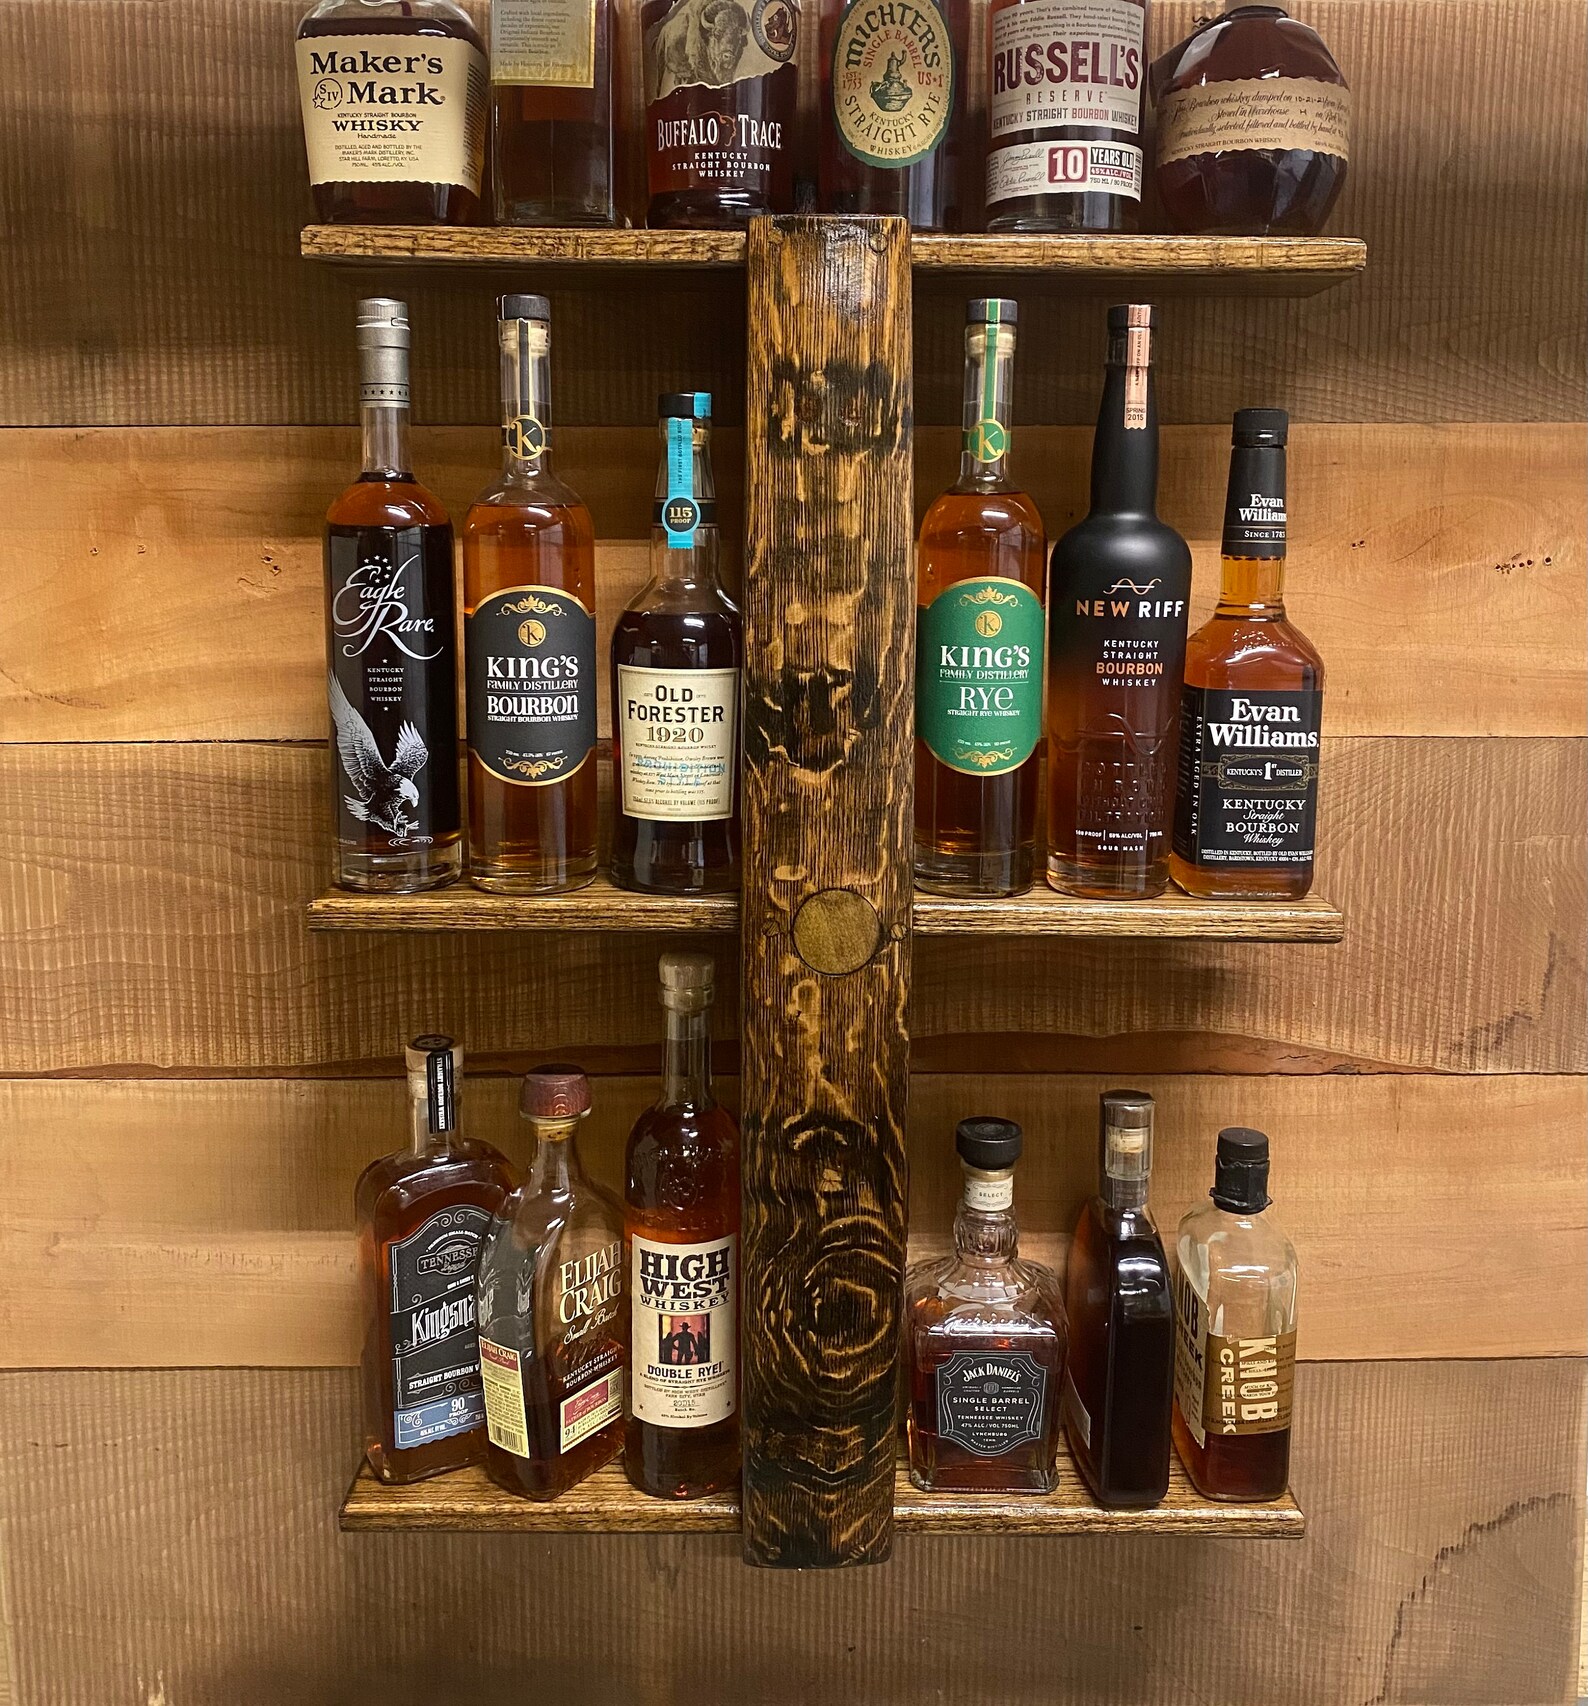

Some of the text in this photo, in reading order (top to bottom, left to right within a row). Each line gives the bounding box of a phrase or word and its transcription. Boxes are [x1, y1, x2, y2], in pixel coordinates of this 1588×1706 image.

[863, 30, 922, 68] SINGLE BARREL
[310, 51, 444, 74] Maker's
[994, 41, 1139, 95] RUSSELL'S
[842, 79, 862, 92] 1753
[1026, 90, 1104, 104] RESERVE
[332, 120, 424, 132] WHISKY
[844, 95, 918, 144] STRAIGHT
[918, 92, 940, 126] RYE
[870, 111, 914, 126] KENTUCKY
[992, 108, 1137, 130] KENTUCKY STRAIGHT BOURBON WHISKEY
[657, 114, 782, 152] BUFFALO TRACE
[870, 144, 912, 155] WHISKEY
[1195, 141, 1222, 150] STRAIGHT
[672, 161, 770, 172] STRAIGHT BOURBON
[1052, 149, 1084, 180] 10
[1091, 148, 1134, 170] YEARS OLD
[1250, 494, 1284, 508] Evan
[669, 506, 692, 518] 115
[1244, 530, 1270, 538] SINCE
[332, 554, 419, 638] Eagle
[1076, 600, 1184, 618] NEW RIFF
[342, 601, 444, 660] Rare
[1104, 640, 1159, 648] KENTUCKY
[1103, 651, 1158, 660] STRAIGHT
[1096, 662, 1164, 675] BOURBON
[1102, 678, 1157, 687] WHISKEY
[656, 684, 693, 702] OLD
[627, 699, 724, 723] FORESTER
[1230, 698, 1300, 722] Evan
[646, 726, 704, 743] 1920
[1194, 716, 1203, 752] EXTRA
[1226, 768, 1262, 776] KENTUCKY'S
[1276, 768, 1302, 776] DISTILLER
[1192, 794, 1199, 808] IN
[1222, 799, 1306, 810] KENTUCKY
[1190, 812, 1198, 836] OAK
[1243, 809, 1285, 823] Straight
[1226, 822, 1300, 834] BOURBON
[1243, 834, 1284, 848] Whiskey
[560, 1240, 622, 1296] ELIJAH
[640, 1246, 730, 1282] HIGH
[560, 1268, 622, 1324] CRAIG
[640, 1274, 730, 1300] WEST
[640, 1291, 730, 1312] WHISKEY
[564, 1302, 620, 1345] Small Batch
[498, 1348, 517, 1362] CRAIG
[408, 1374, 442, 1390] STRAIGHT
[444, 1365, 474, 1380] BOURBON
[562, 1360, 592, 1384] KENTUCKY
[647, 1361, 722, 1379] DOUBLE RYE!
[962, 1362, 1022, 1382] JACK DANIEL'S
[1238, 1337, 1278, 1420] KNOB
[1220, 1348, 1236, 1434] CREEK
[448, 1408, 468, 1418] PROOF
[451, 1396, 465, 1412] 90
